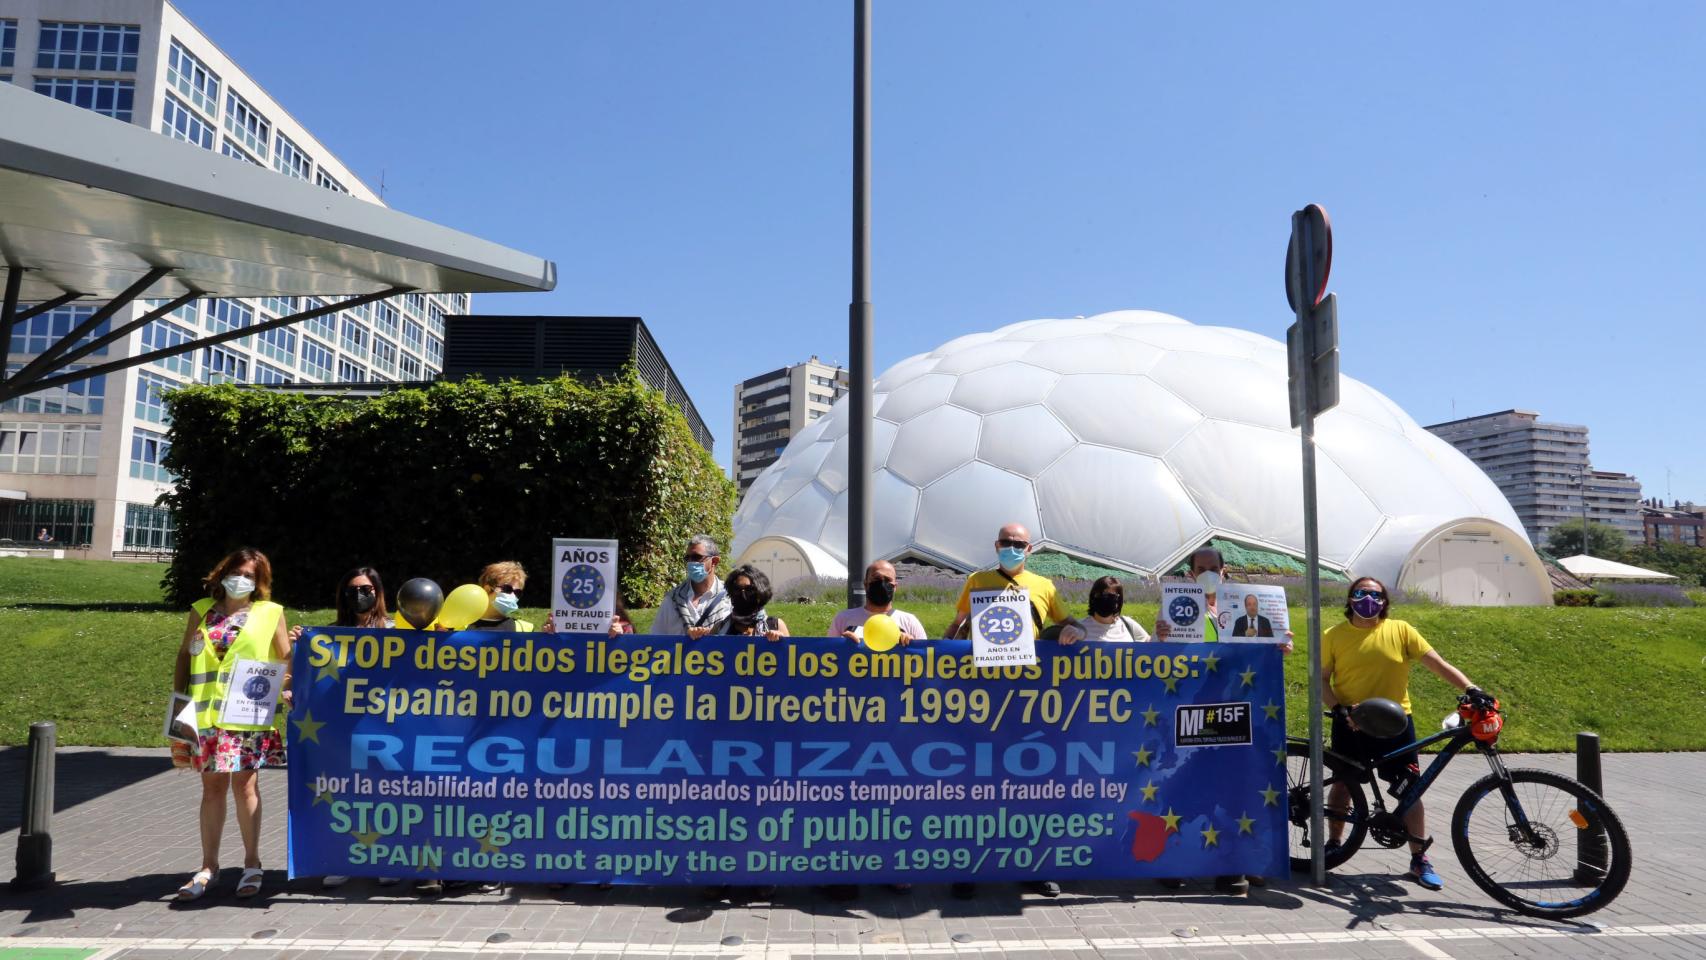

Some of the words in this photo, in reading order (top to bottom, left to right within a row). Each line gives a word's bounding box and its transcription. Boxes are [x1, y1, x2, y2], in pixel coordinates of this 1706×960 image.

[561, 548, 610, 564] AÑOS
[572, 579, 594, 594] 25
[972, 594, 1026, 604] INTERINO
[555, 609, 569, 617] EN
[571, 610, 612, 618] FRAUDE
[1175, 605, 1194, 617] 20
[565, 622, 578, 630] DE
[580, 623, 600, 631] LEY
[987, 618, 1015, 633] 29
[308, 635, 406, 669] STOP
[414, 637, 576, 679] despidos
[585, 641, 725, 682] ilegales
[734, 643, 778, 677] de
[787, 644, 839, 678] los
[1052, 645, 1199, 687] públicos:
[252, 684, 264, 693] 18
[344, 678, 478, 724] España
[489, 690, 532, 718] no
[542, 685, 674, 728] cumple
[685, 685, 717, 721] la
[729, 685, 886, 723] Directiva
[900, 688, 1133, 732] 1999/70/EC
[1180, 709, 1204, 736] MI
[1206, 706, 1245, 724] #15F
[351, 730, 1116, 777] REGULARIZACIÓN
[315, 775, 349, 797] por
[354, 773, 373, 795] la
[378, 775, 497, 799] estabilidad
[502, 777, 529, 800] de
[534, 778, 594, 800] todos
[600, 778, 630, 800] los
[635, 779, 750, 805] empleados
[756, 779, 844, 806] públicos
[850, 780, 966, 806] temporales
[971, 784, 995, 801] en
[1001, 779, 1066, 800] fraude
[1071, 779, 1095, 799] de
[1101, 778, 1128, 803] ley
[329, 800, 424, 836] STOP
[433, 804, 545, 847] illegal
[555, 806, 748, 842] dismissals
[757, 808, 795, 842] of
[803, 808, 912, 849] public
[922, 807, 1114, 847] employees:
[349, 843, 443, 867] SPAIN
[452, 847, 527, 869] does
[535, 850, 587, 870] not
[594, 850, 679, 876] apply
[686, 850, 737, 872] the
[747, 850, 884, 872] Directive
[894, 845, 1092, 874] 1999/70/EC
